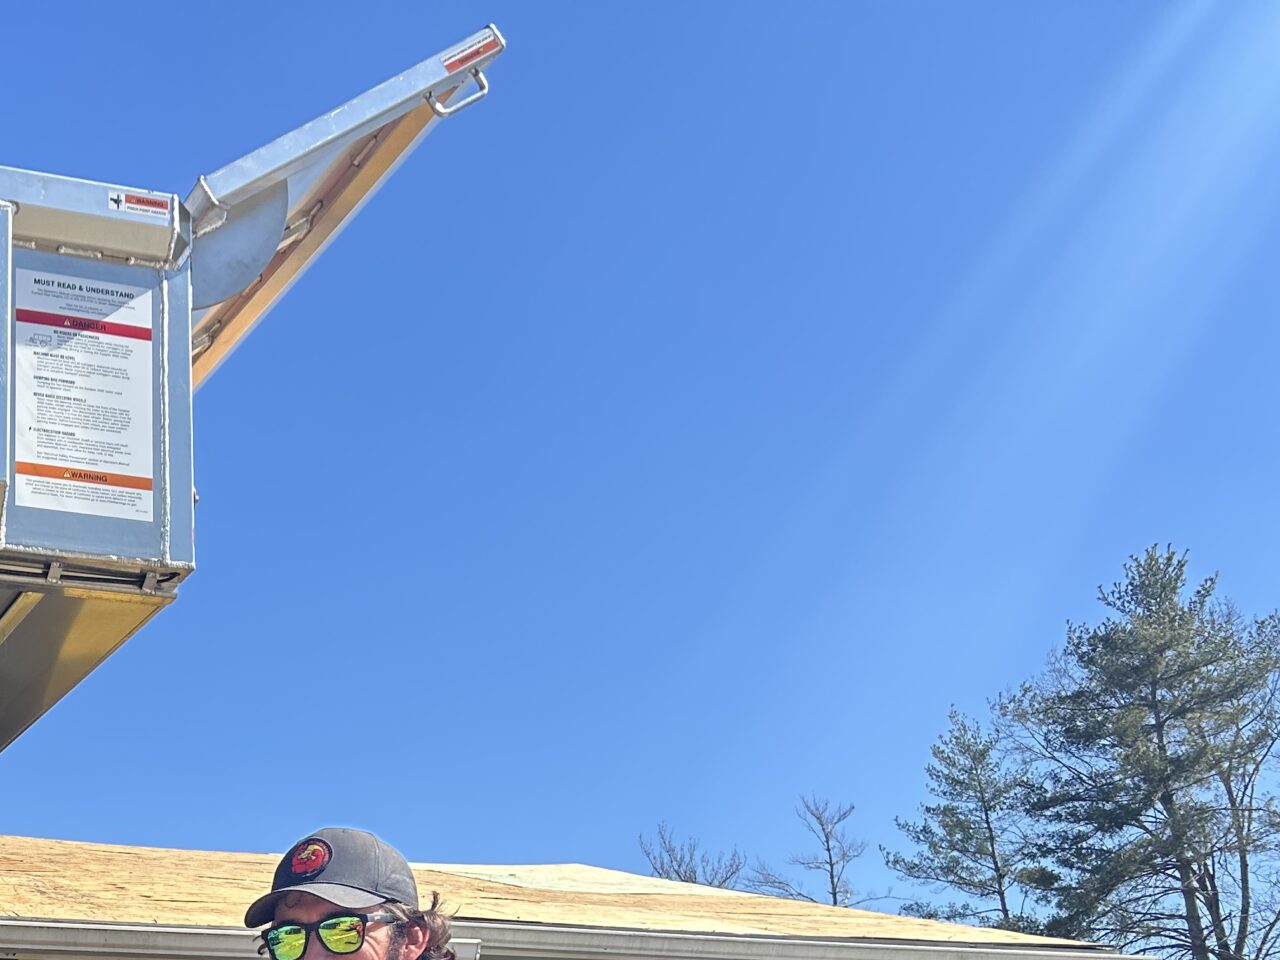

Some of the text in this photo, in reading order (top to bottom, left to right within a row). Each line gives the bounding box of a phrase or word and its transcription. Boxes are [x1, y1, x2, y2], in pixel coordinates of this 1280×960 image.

[34, 277, 54, 287] MUST
[57, 281, 76, 290] READ
[86, 286, 134, 299] UNDERSTAND
[72, 320, 105, 331] DANGER
[71, 471, 107, 482] WARNING
